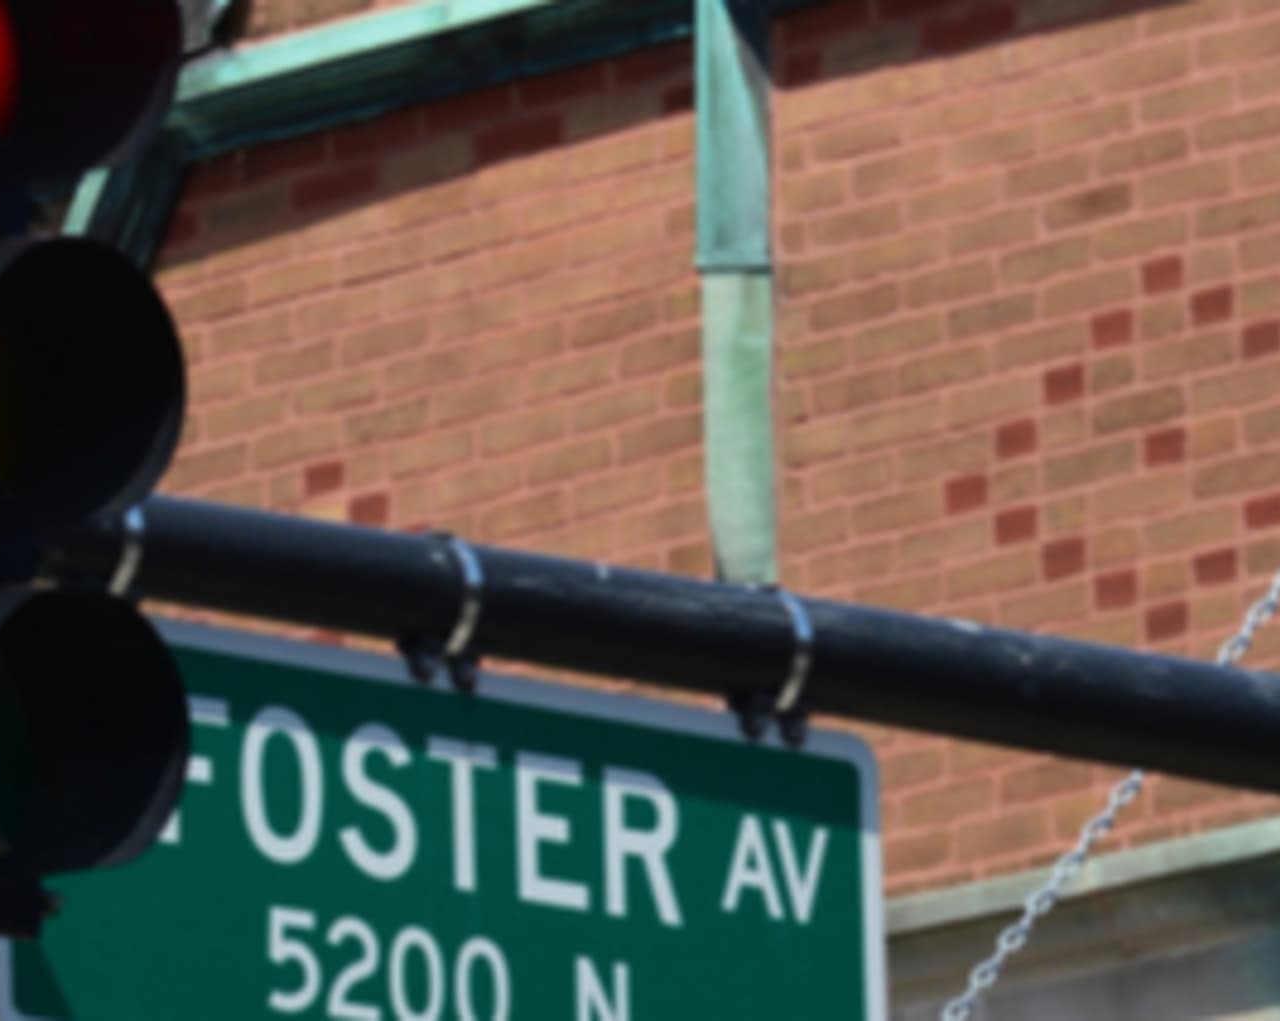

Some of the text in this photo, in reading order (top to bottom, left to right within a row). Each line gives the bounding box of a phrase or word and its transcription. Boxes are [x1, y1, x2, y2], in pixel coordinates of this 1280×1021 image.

[721, 815, 829, 925] AV
[267, 906, 630, 1021] 5200 N
